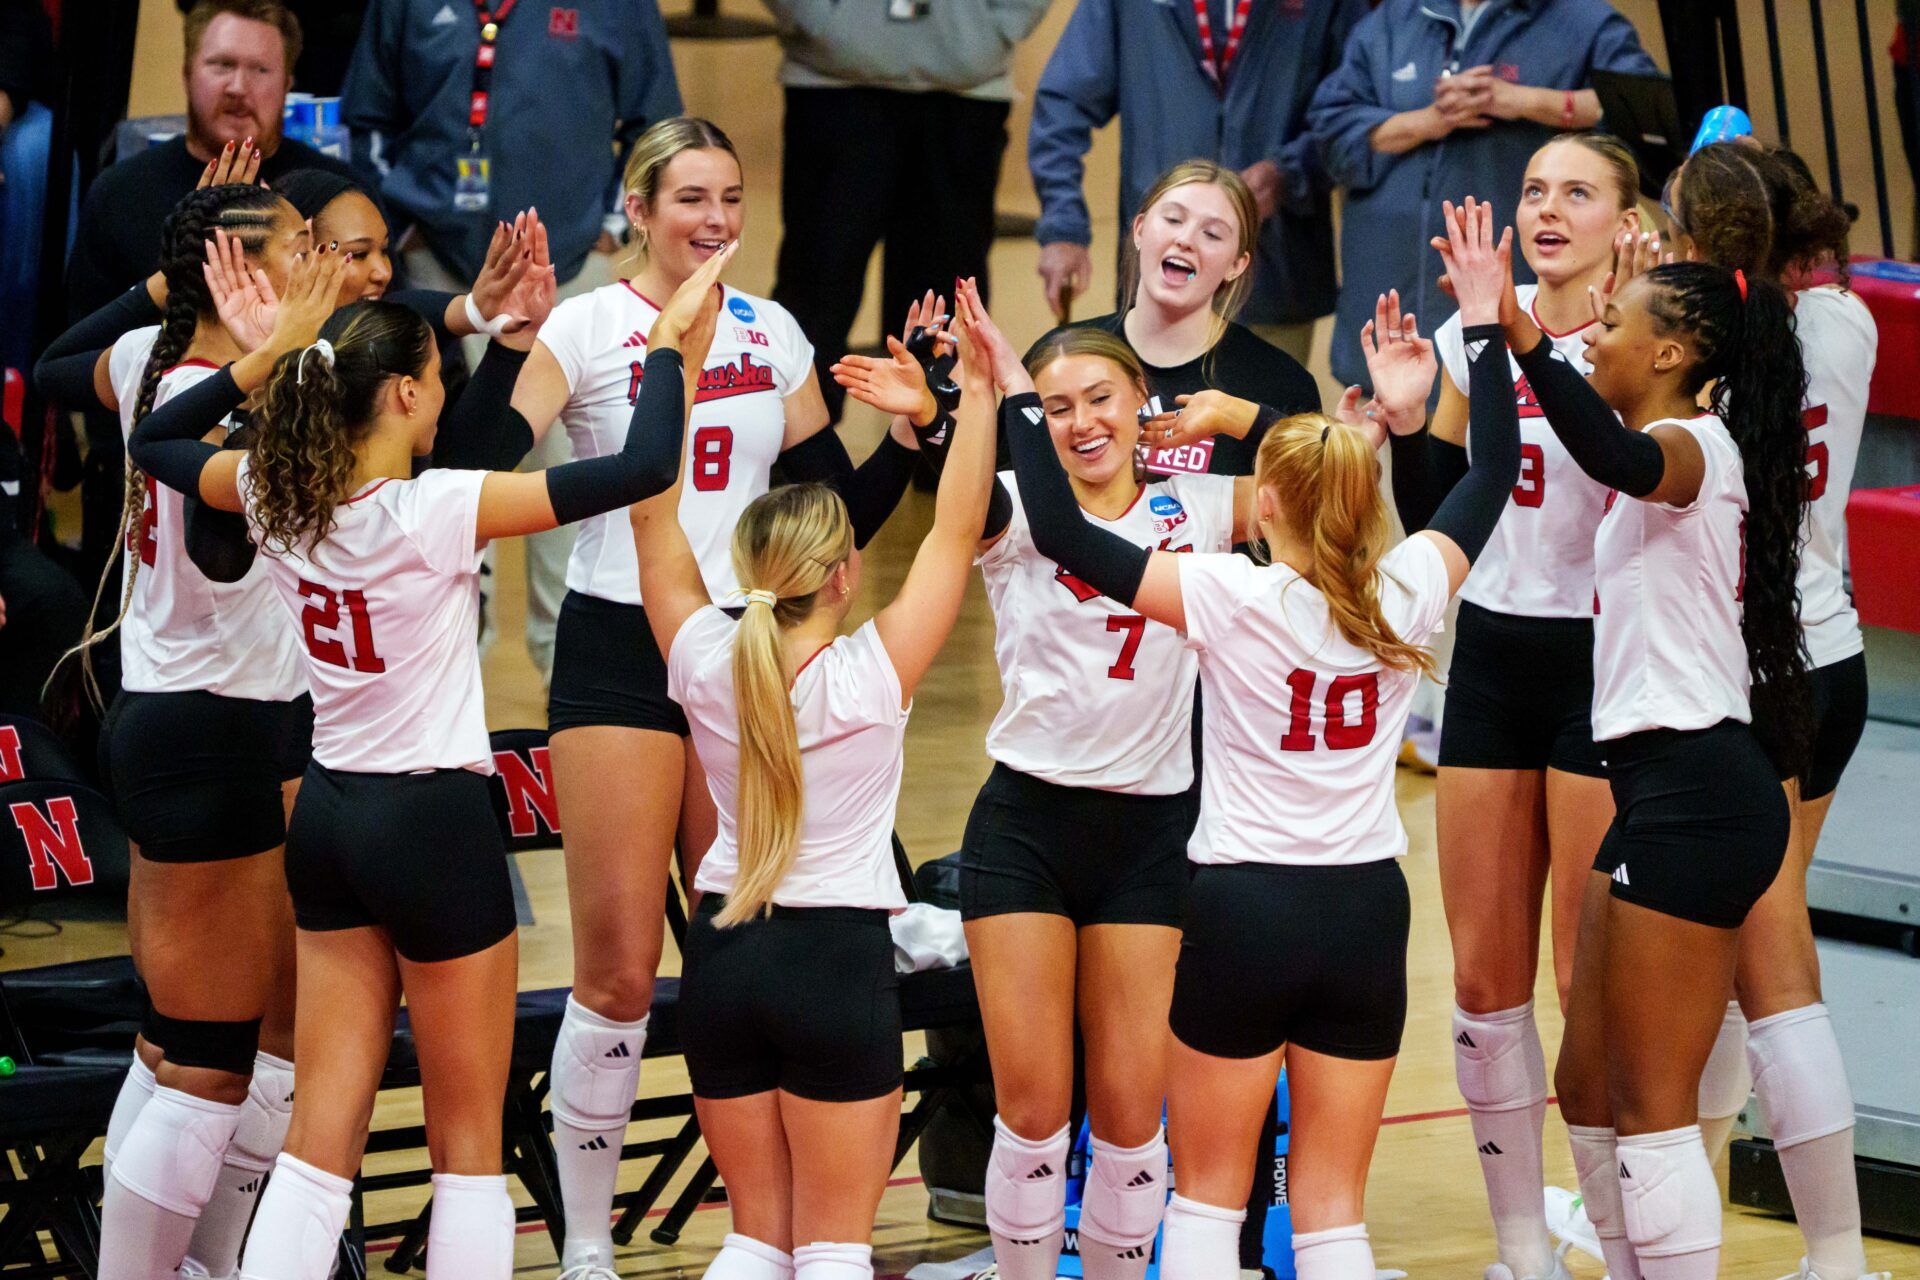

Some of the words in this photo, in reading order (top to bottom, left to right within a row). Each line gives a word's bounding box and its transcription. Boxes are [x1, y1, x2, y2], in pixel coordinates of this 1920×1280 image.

[693, 425, 734, 491] 8
[1156, 445, 1207, 471] RED
[298, 577, 386, 673] 21
[1106, 614, 1147, 681] 7
[1280, 667, 1380, 751] 10
[492, 747, 561, 837] N
[9, 796, 94, 891] N
